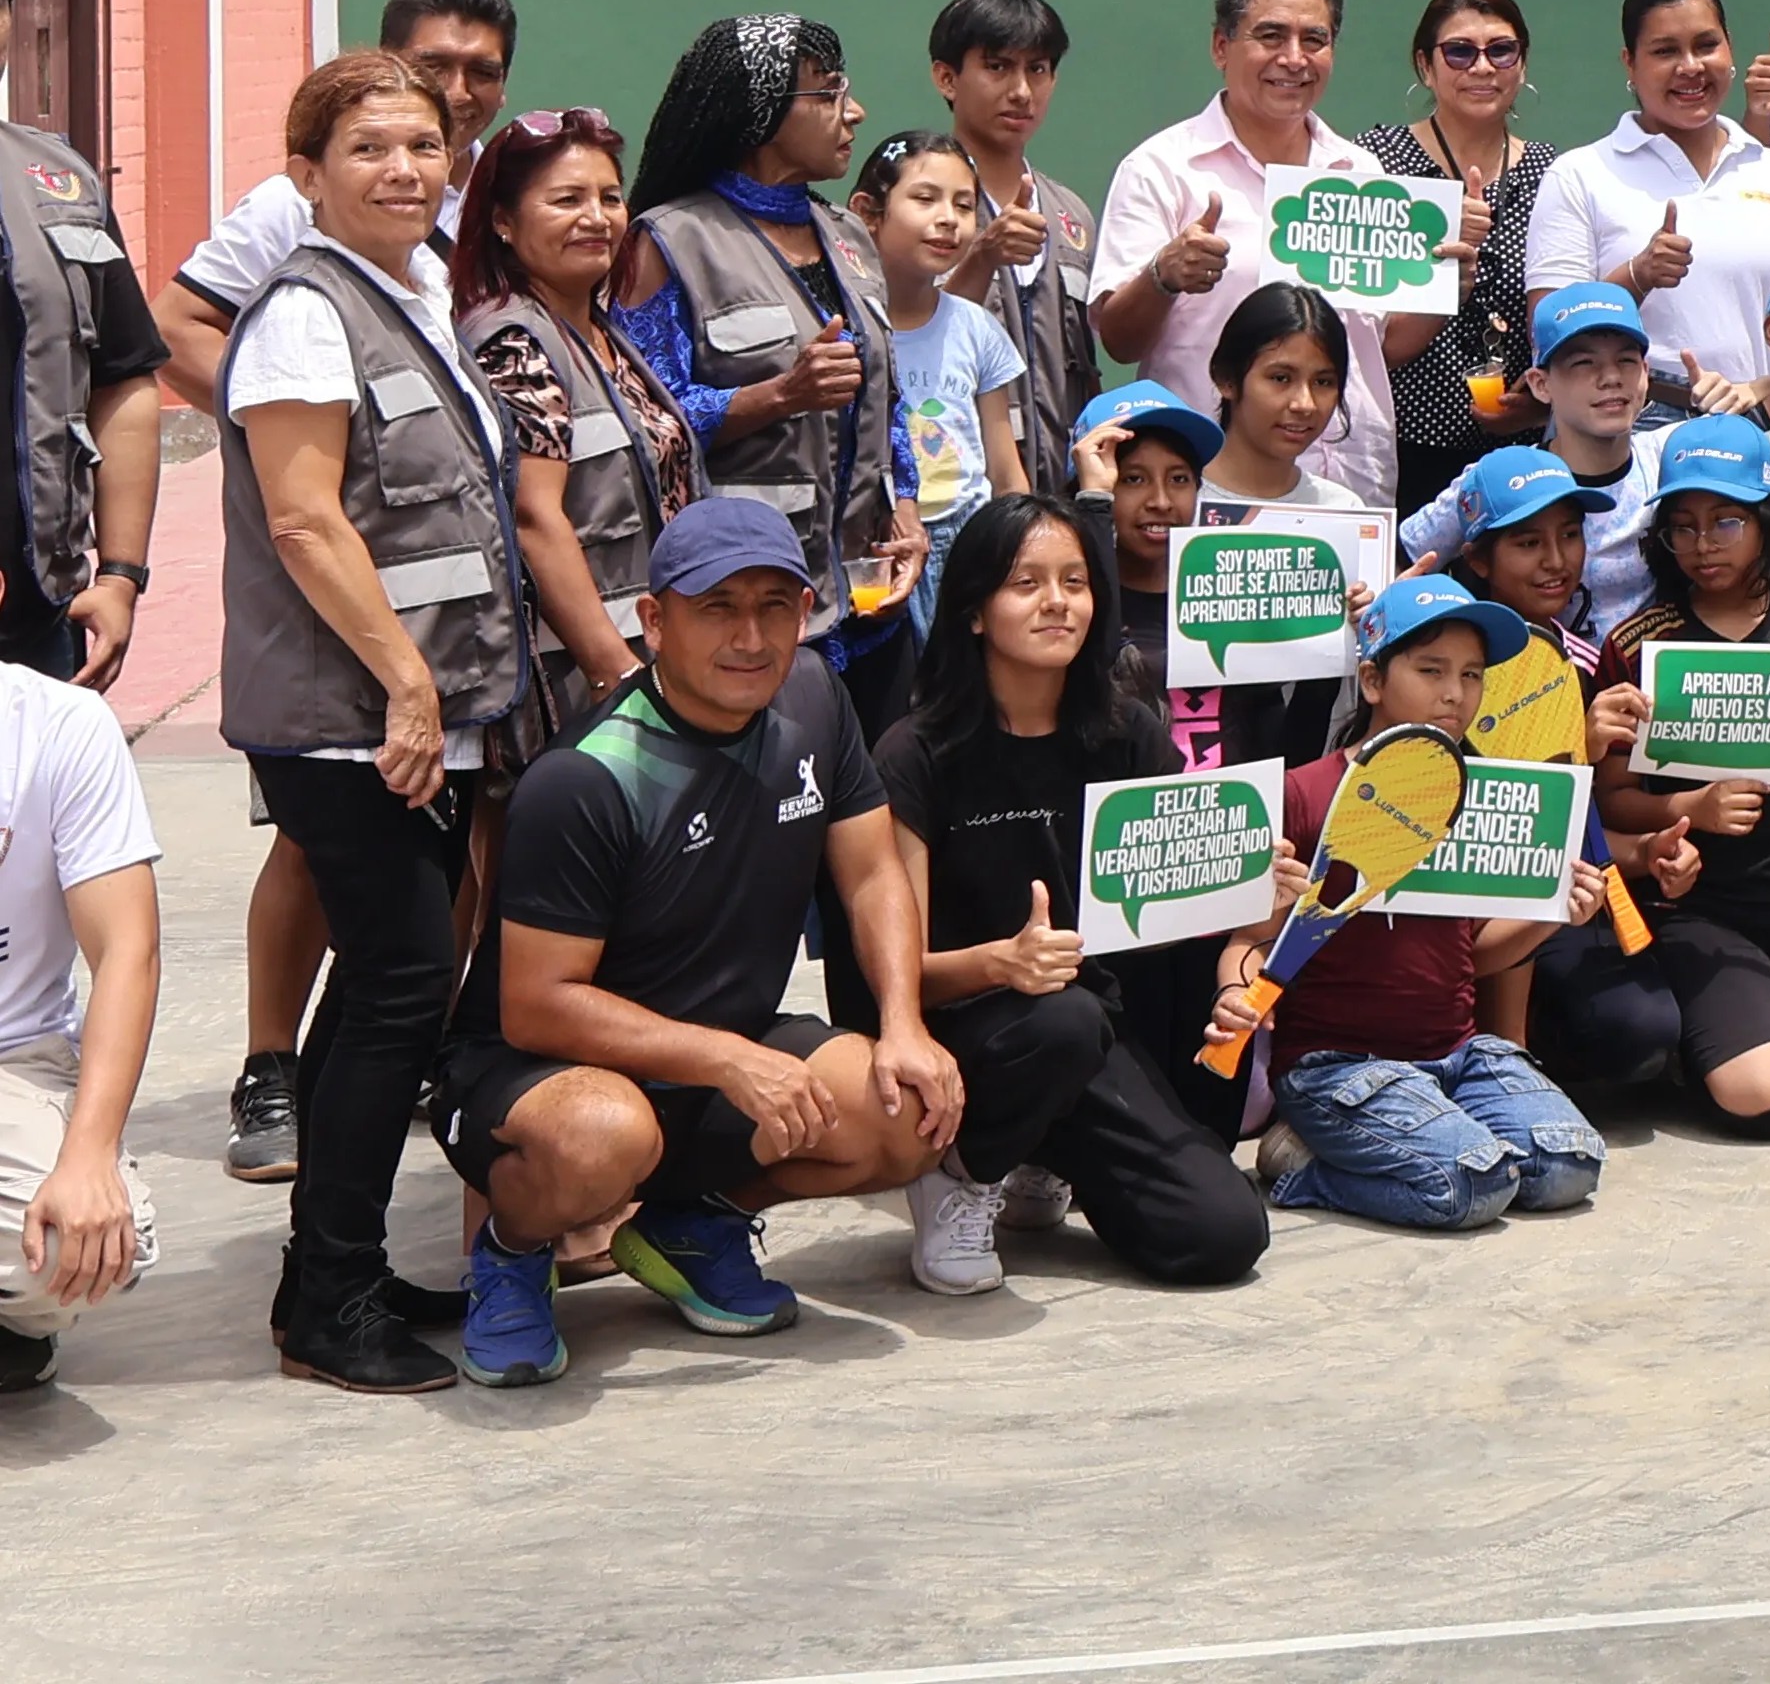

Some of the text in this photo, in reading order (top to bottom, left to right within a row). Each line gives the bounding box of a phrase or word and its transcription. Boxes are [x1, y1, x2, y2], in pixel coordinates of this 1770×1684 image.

[1308, 191, 1410, 229] ESTAMOS
[1287, 221, 1426, 261] ORGULLOSOS
[1329, 256, 1383, 288] DE TI
[1216, 548, 1315, 572] SOY PARTE DE
[1186, 569, 1339, 597] LOS QUE SE ATREVEN A
[1180, 590, 1341, 624] APRENDER E IR POR MÁS
[1682, 673, 1763, 695] APRENDER
[1499, 704, 1520, 720] LUZ
[1691, 698, 1742, 719] NUEVO
[1745, 699, 1764, 719] ES
[1651, 718, 1715, 742] DESAFÍO
[778, 803, 824, 824] MARTINEZ
[779, 795, 816, 814] KEVIN
[1154, 784, 1220, 816] FELIZ DE
[1375, 797, 1394, 815] LUZ
[1120, 804, 1247, 847] APROVECHAR MI
[1445, 810, 1533, 845] RENDER
[1095, 827, 1269, 875] VERANO APRENDIENDO
[1462, 842, 1563, 878] FRONTÓN
[1124, 857, 1242, 899] Y DISFRUTANDO
